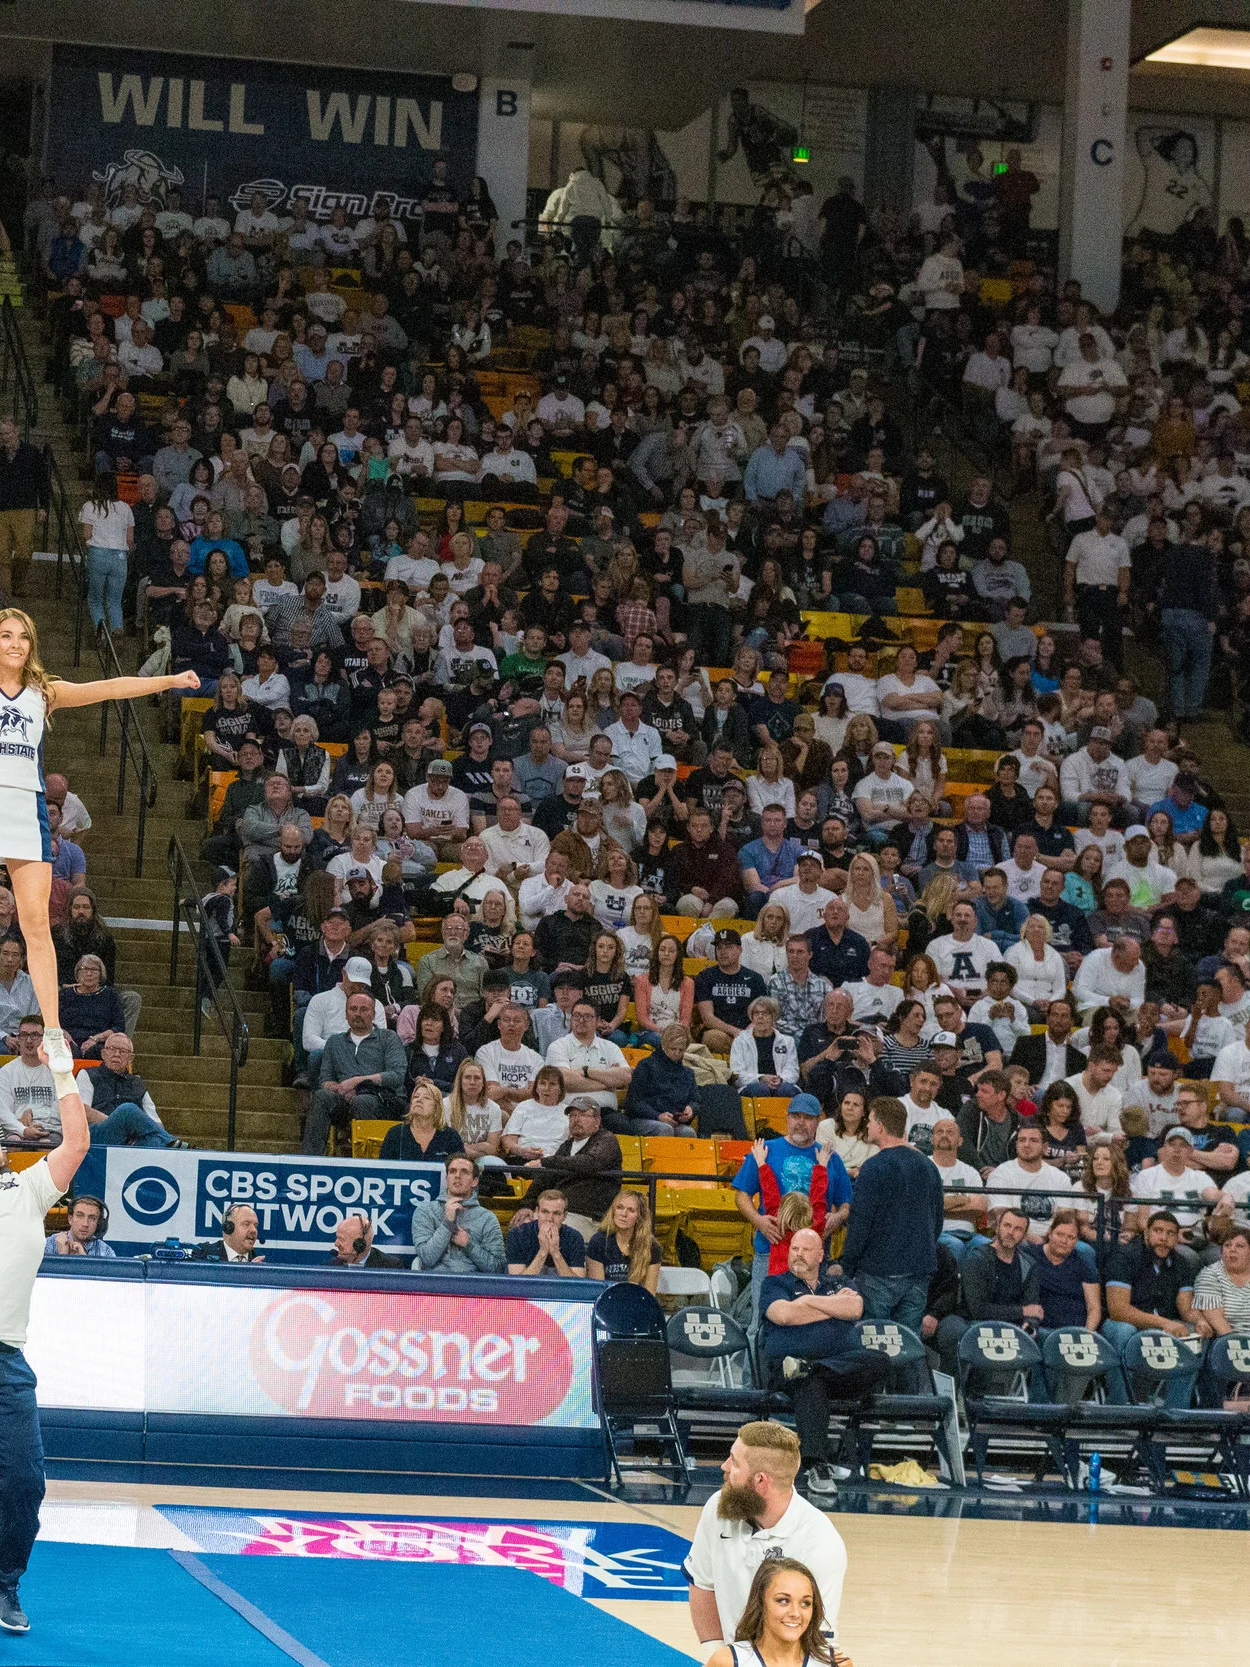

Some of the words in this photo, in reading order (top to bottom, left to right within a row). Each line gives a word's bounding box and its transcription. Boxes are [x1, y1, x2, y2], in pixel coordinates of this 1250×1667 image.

[97, 71, 265, 136] WILL
[305, 89, 444, 151] WIN
[495, 90, 518, 117] B
[1089, 139, 1114, 168] C
[8, 743, 36, 760] STATE
[948, 952, 981, 979] A
[501, 1072, 528, 1082] HOOPS
[205, 1169, 278, 1201] CBS
[286, 1172, 432, 1207] SPORTS
[204, 1199, 395, 1237] NTWOK
[264, 1295, 541, 1411] Gossner
[343, 1382, 498, 1413] FOODS
